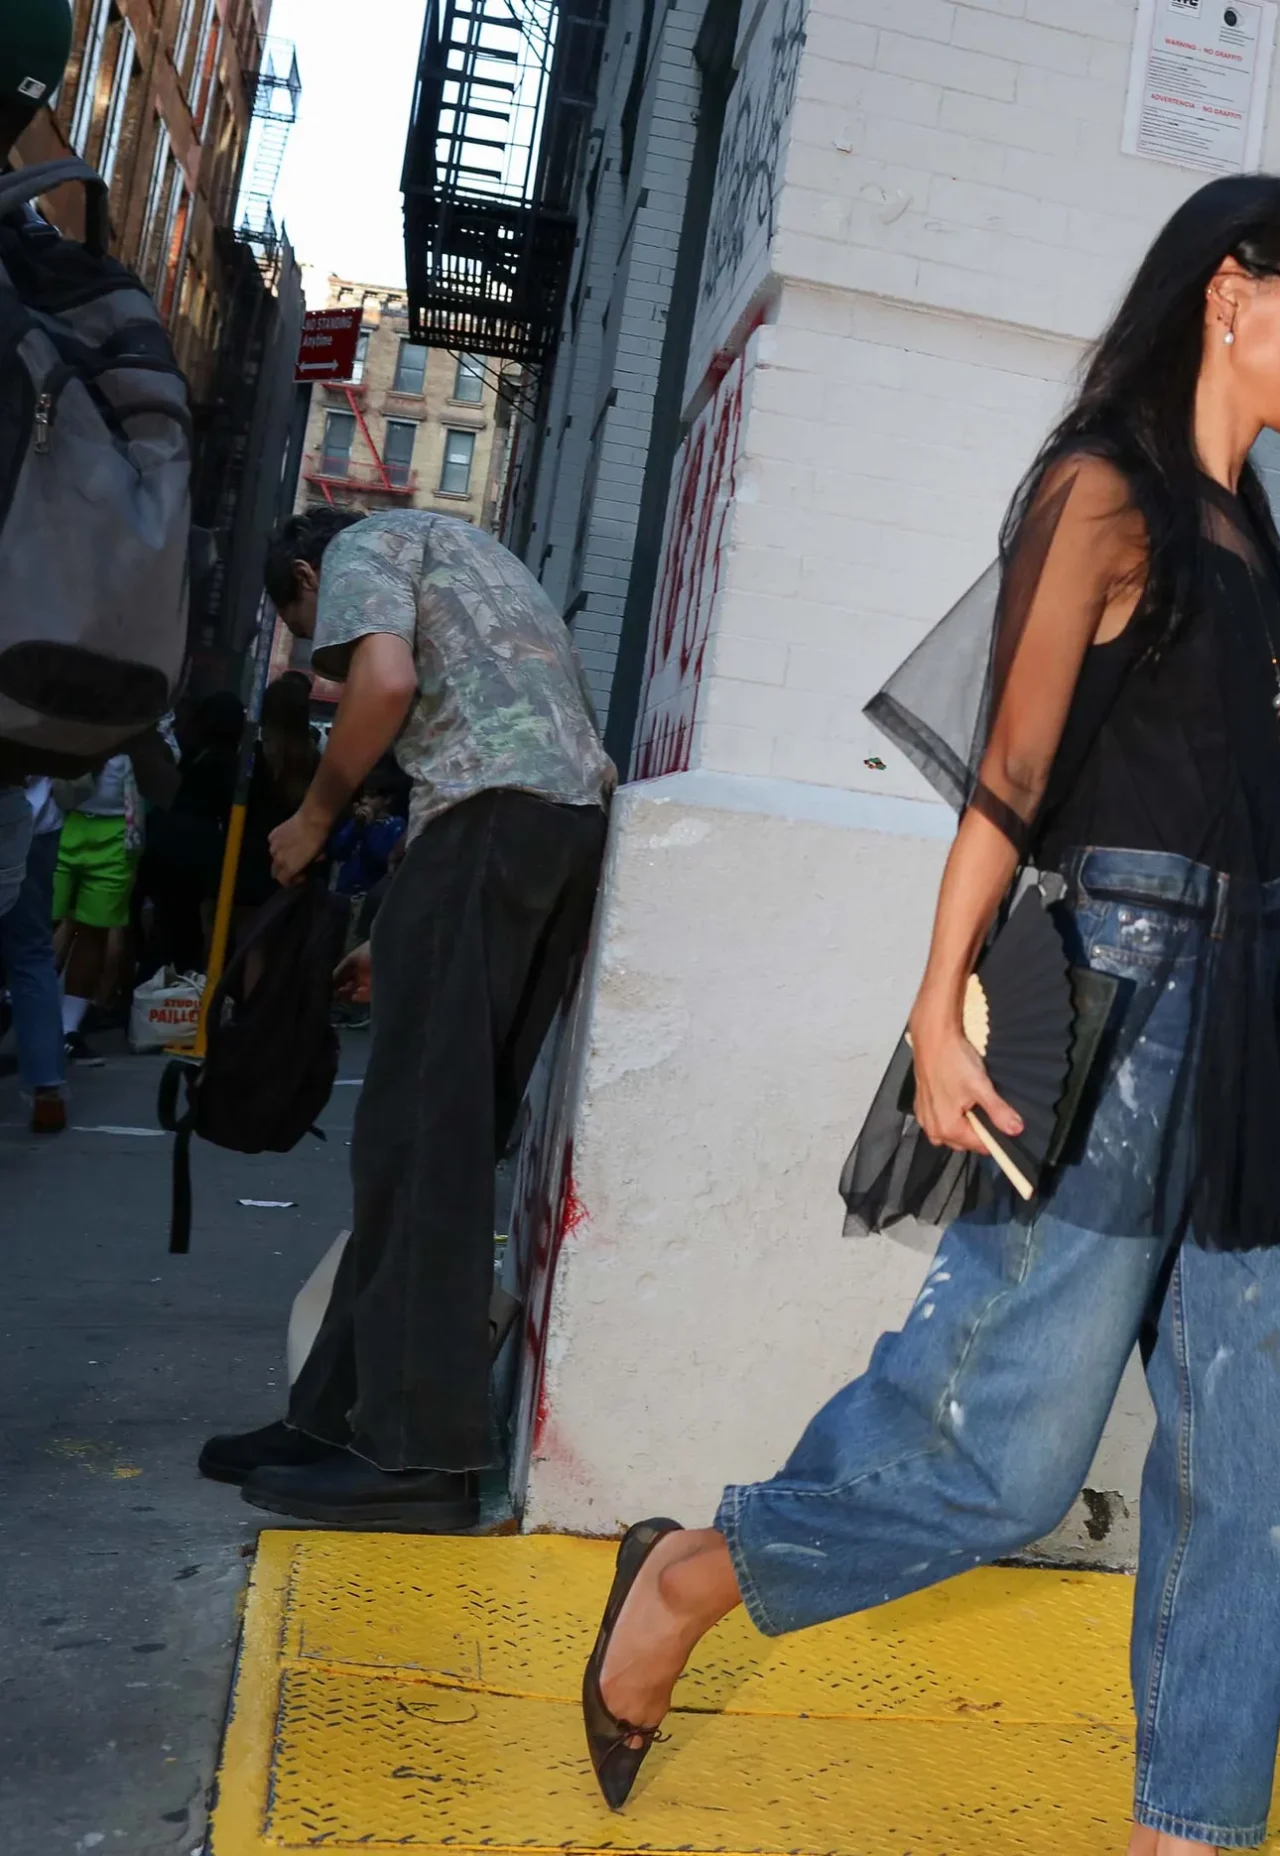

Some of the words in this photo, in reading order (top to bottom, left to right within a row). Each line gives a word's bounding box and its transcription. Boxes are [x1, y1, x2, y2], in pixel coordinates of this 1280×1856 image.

[1164, 37, 1197, 51] WARNING
[1203, 48, 1214, 56] NO
[1214, 50, 1243, 62] GRAFFITI
[1150, 93, 1196, 109] ADVERTENCIA
[1203, 105, 1213, 113] NO
[1214, 107, 1242, 120] GRAFFITI
[317, 316, 353, 330] STANDING
[303, 334, 333, 348] Anytime
[163, 998, 202, 1008] STUDI
